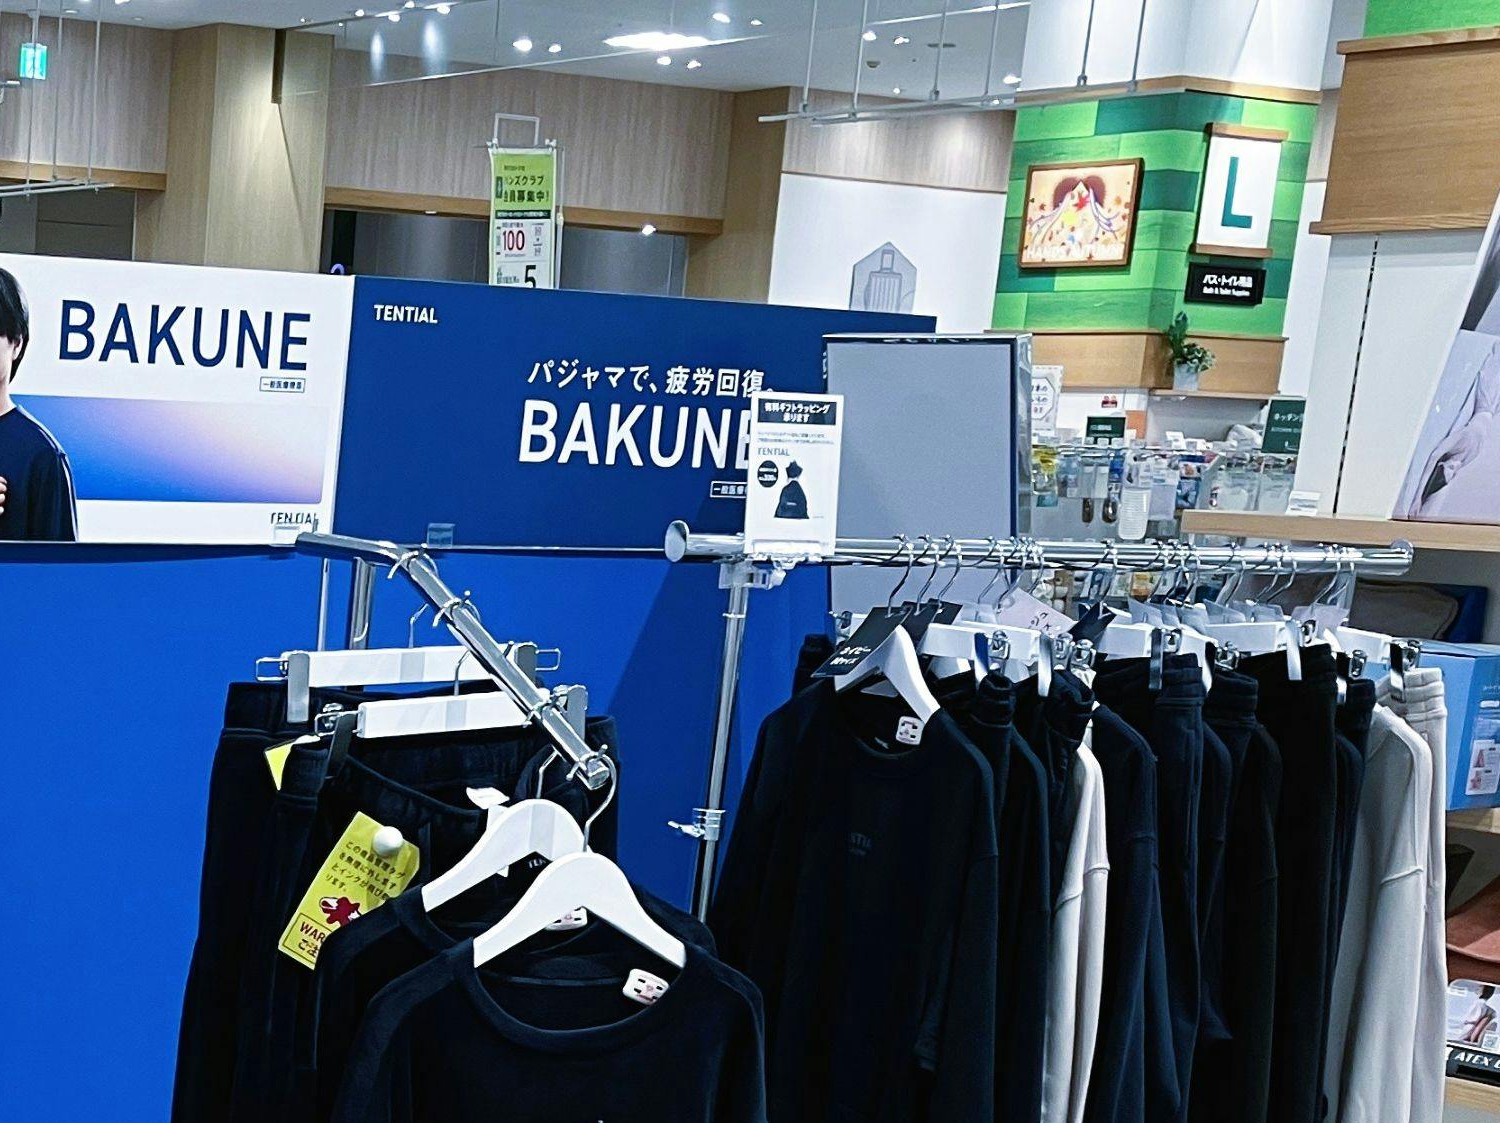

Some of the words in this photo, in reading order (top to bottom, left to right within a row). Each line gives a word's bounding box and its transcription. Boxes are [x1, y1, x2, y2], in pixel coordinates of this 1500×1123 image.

[1221, 156, 1253, 229] L
[503, 230, 525, 251] 100
[59, 300, 311, 371] BAKUNE
[373, 305, 438, 324] TENTIAL
